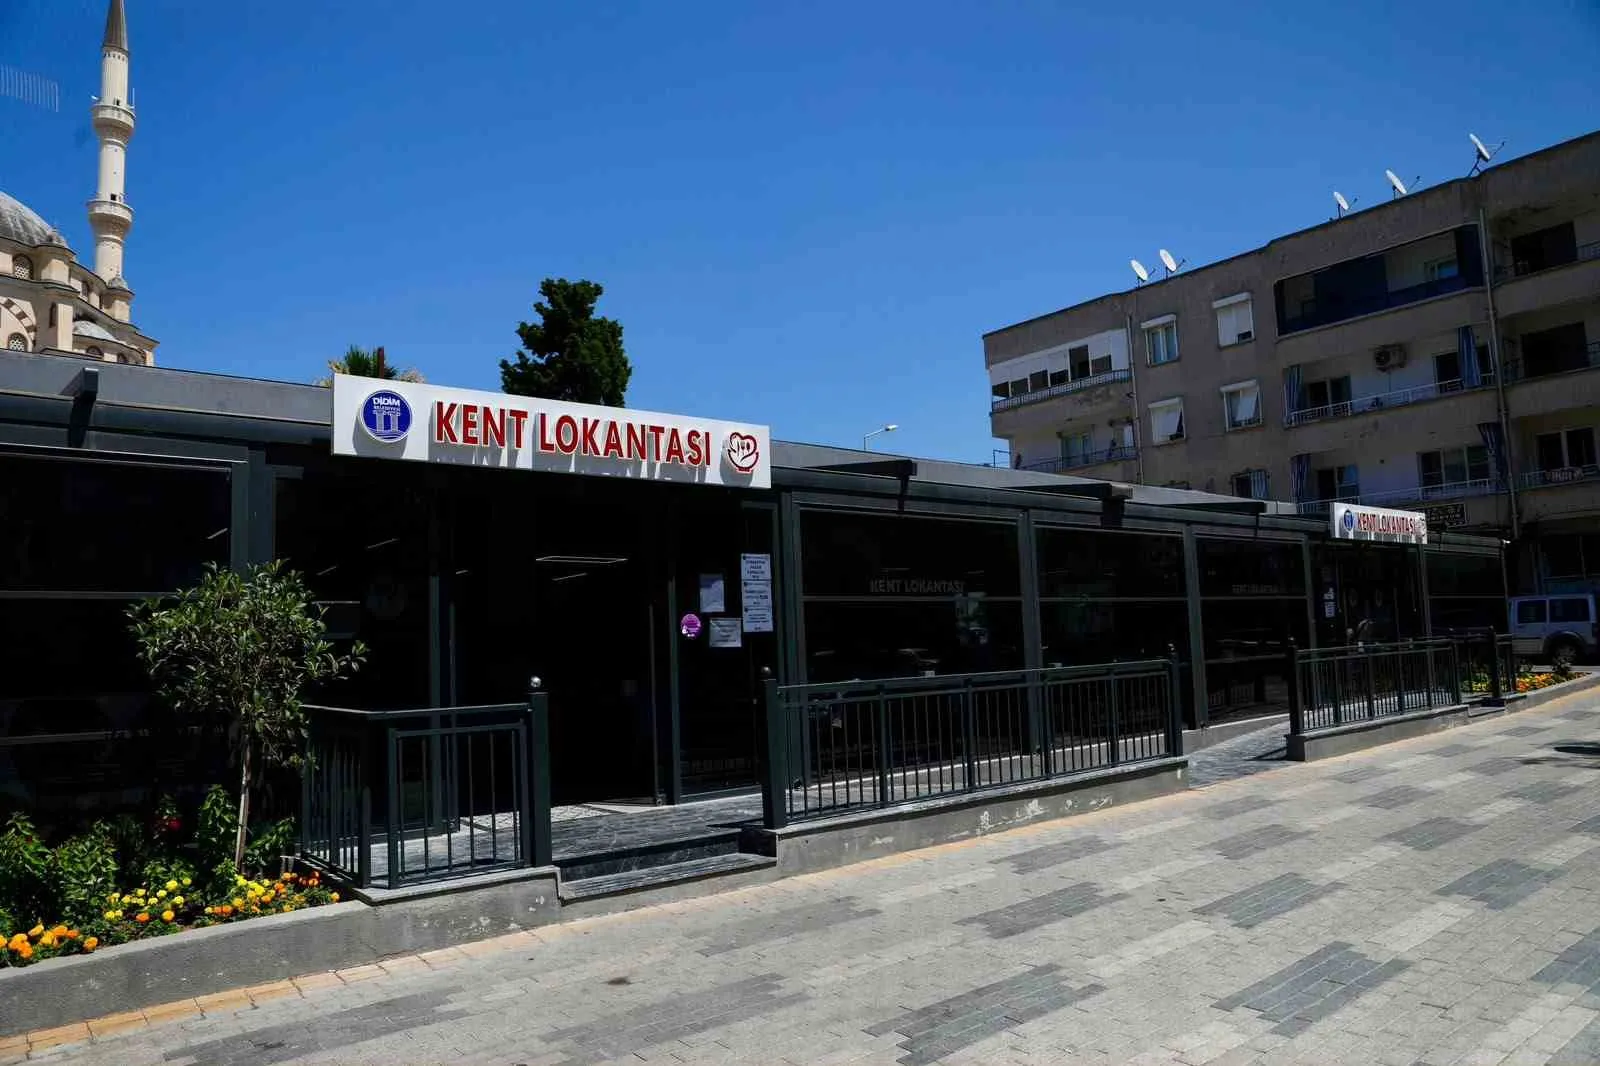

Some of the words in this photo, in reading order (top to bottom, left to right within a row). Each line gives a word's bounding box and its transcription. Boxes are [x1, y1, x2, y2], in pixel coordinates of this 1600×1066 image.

[436, 400, 528, 449] KENT
[539, 412, 711, 466] LOKANTASI
[1357, 511, 1376, 532] KENT
[1378, 514, 1416, 535] LOKANTASI
